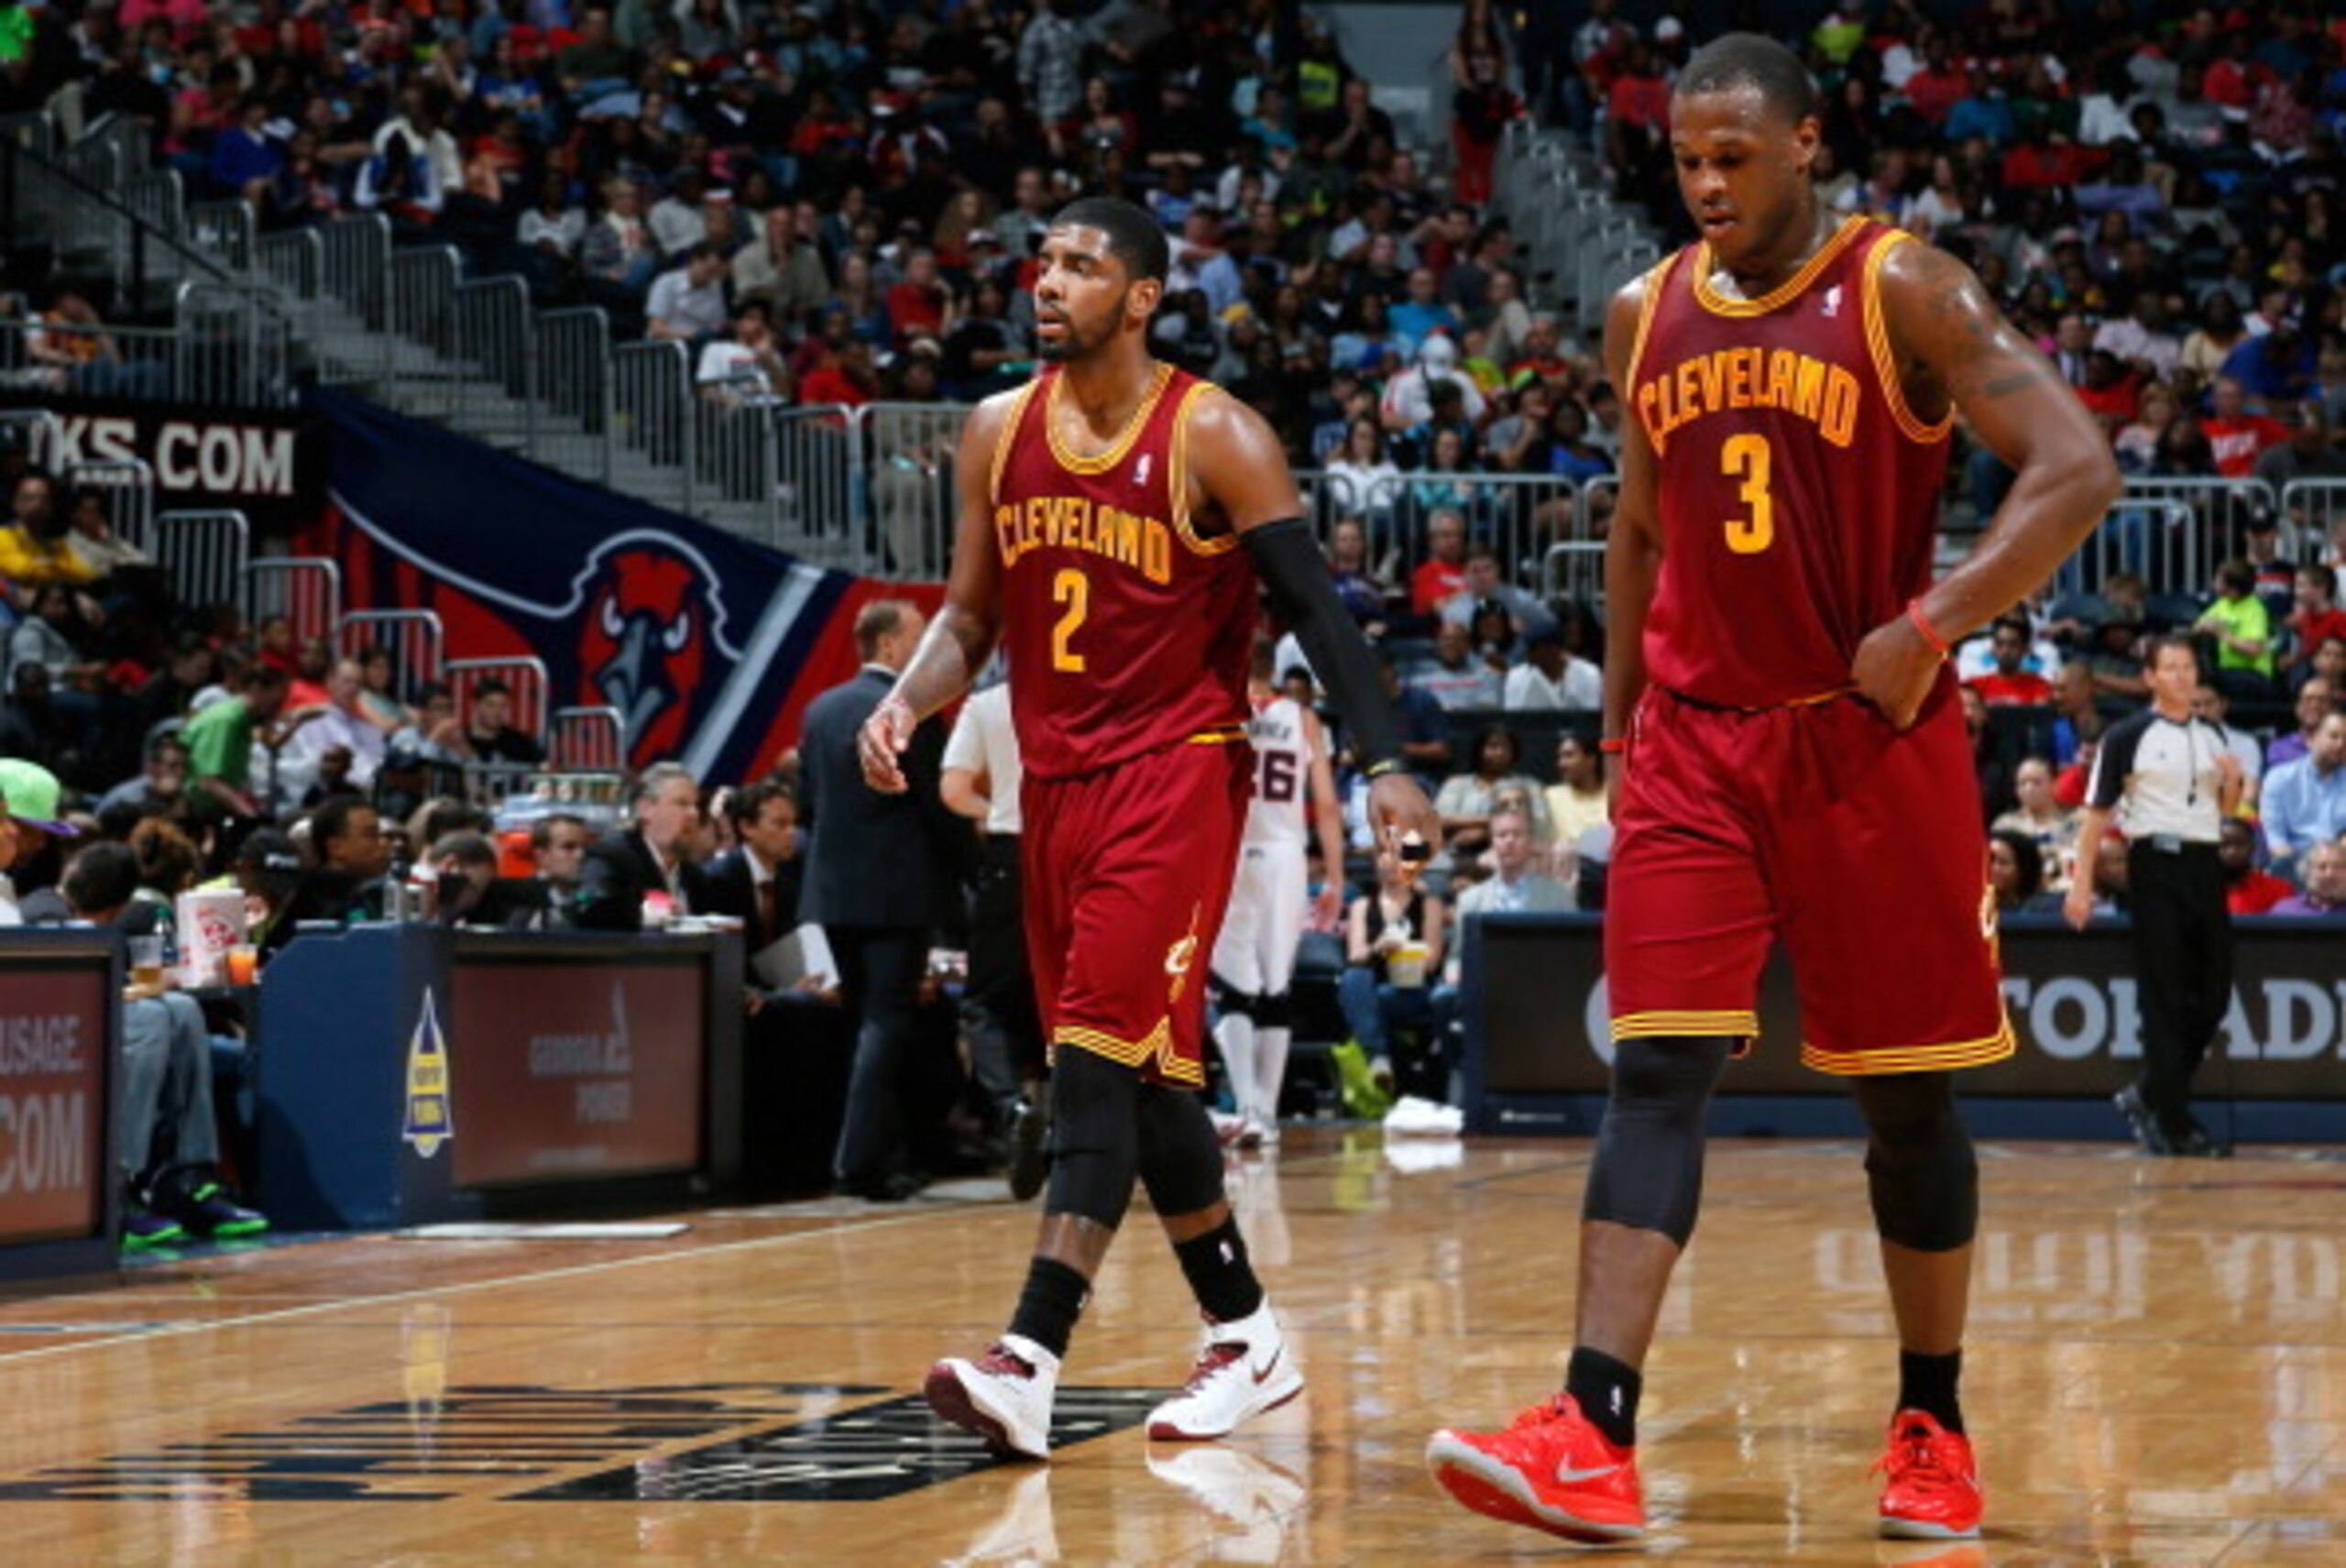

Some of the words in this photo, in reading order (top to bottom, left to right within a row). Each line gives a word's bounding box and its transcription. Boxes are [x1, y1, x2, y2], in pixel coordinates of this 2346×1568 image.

[1638, 347, 1861, 458] CLEVELAND
[995, 496, 1171, 586] CLEVELAND
[1721, 433, 1774, 554] 3
[1052, 568, 1090, 673] 2
[1254, 750, 1297, 802] 6
